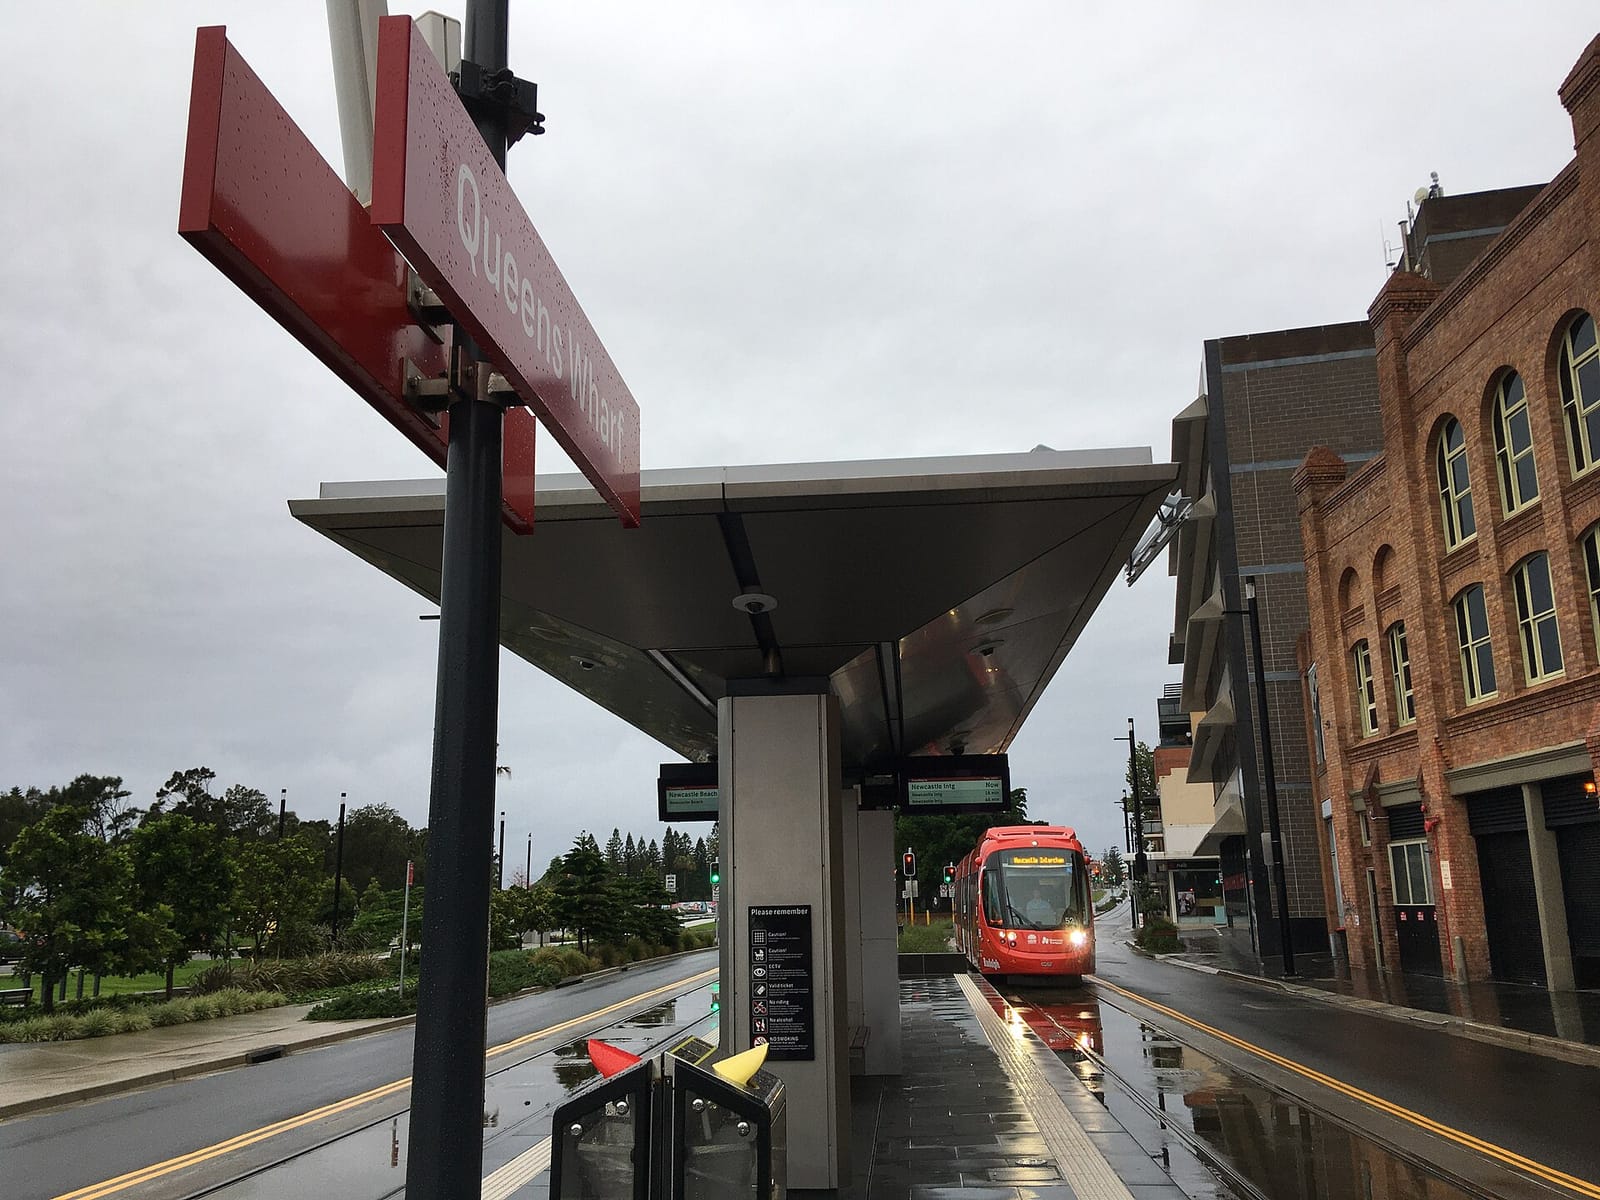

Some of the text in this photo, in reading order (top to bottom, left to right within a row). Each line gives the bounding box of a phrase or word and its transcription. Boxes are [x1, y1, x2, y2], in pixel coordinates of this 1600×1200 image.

[457, 163, 625, 465] Queens Wharf
[751, 907, 808, 916] Please remember
